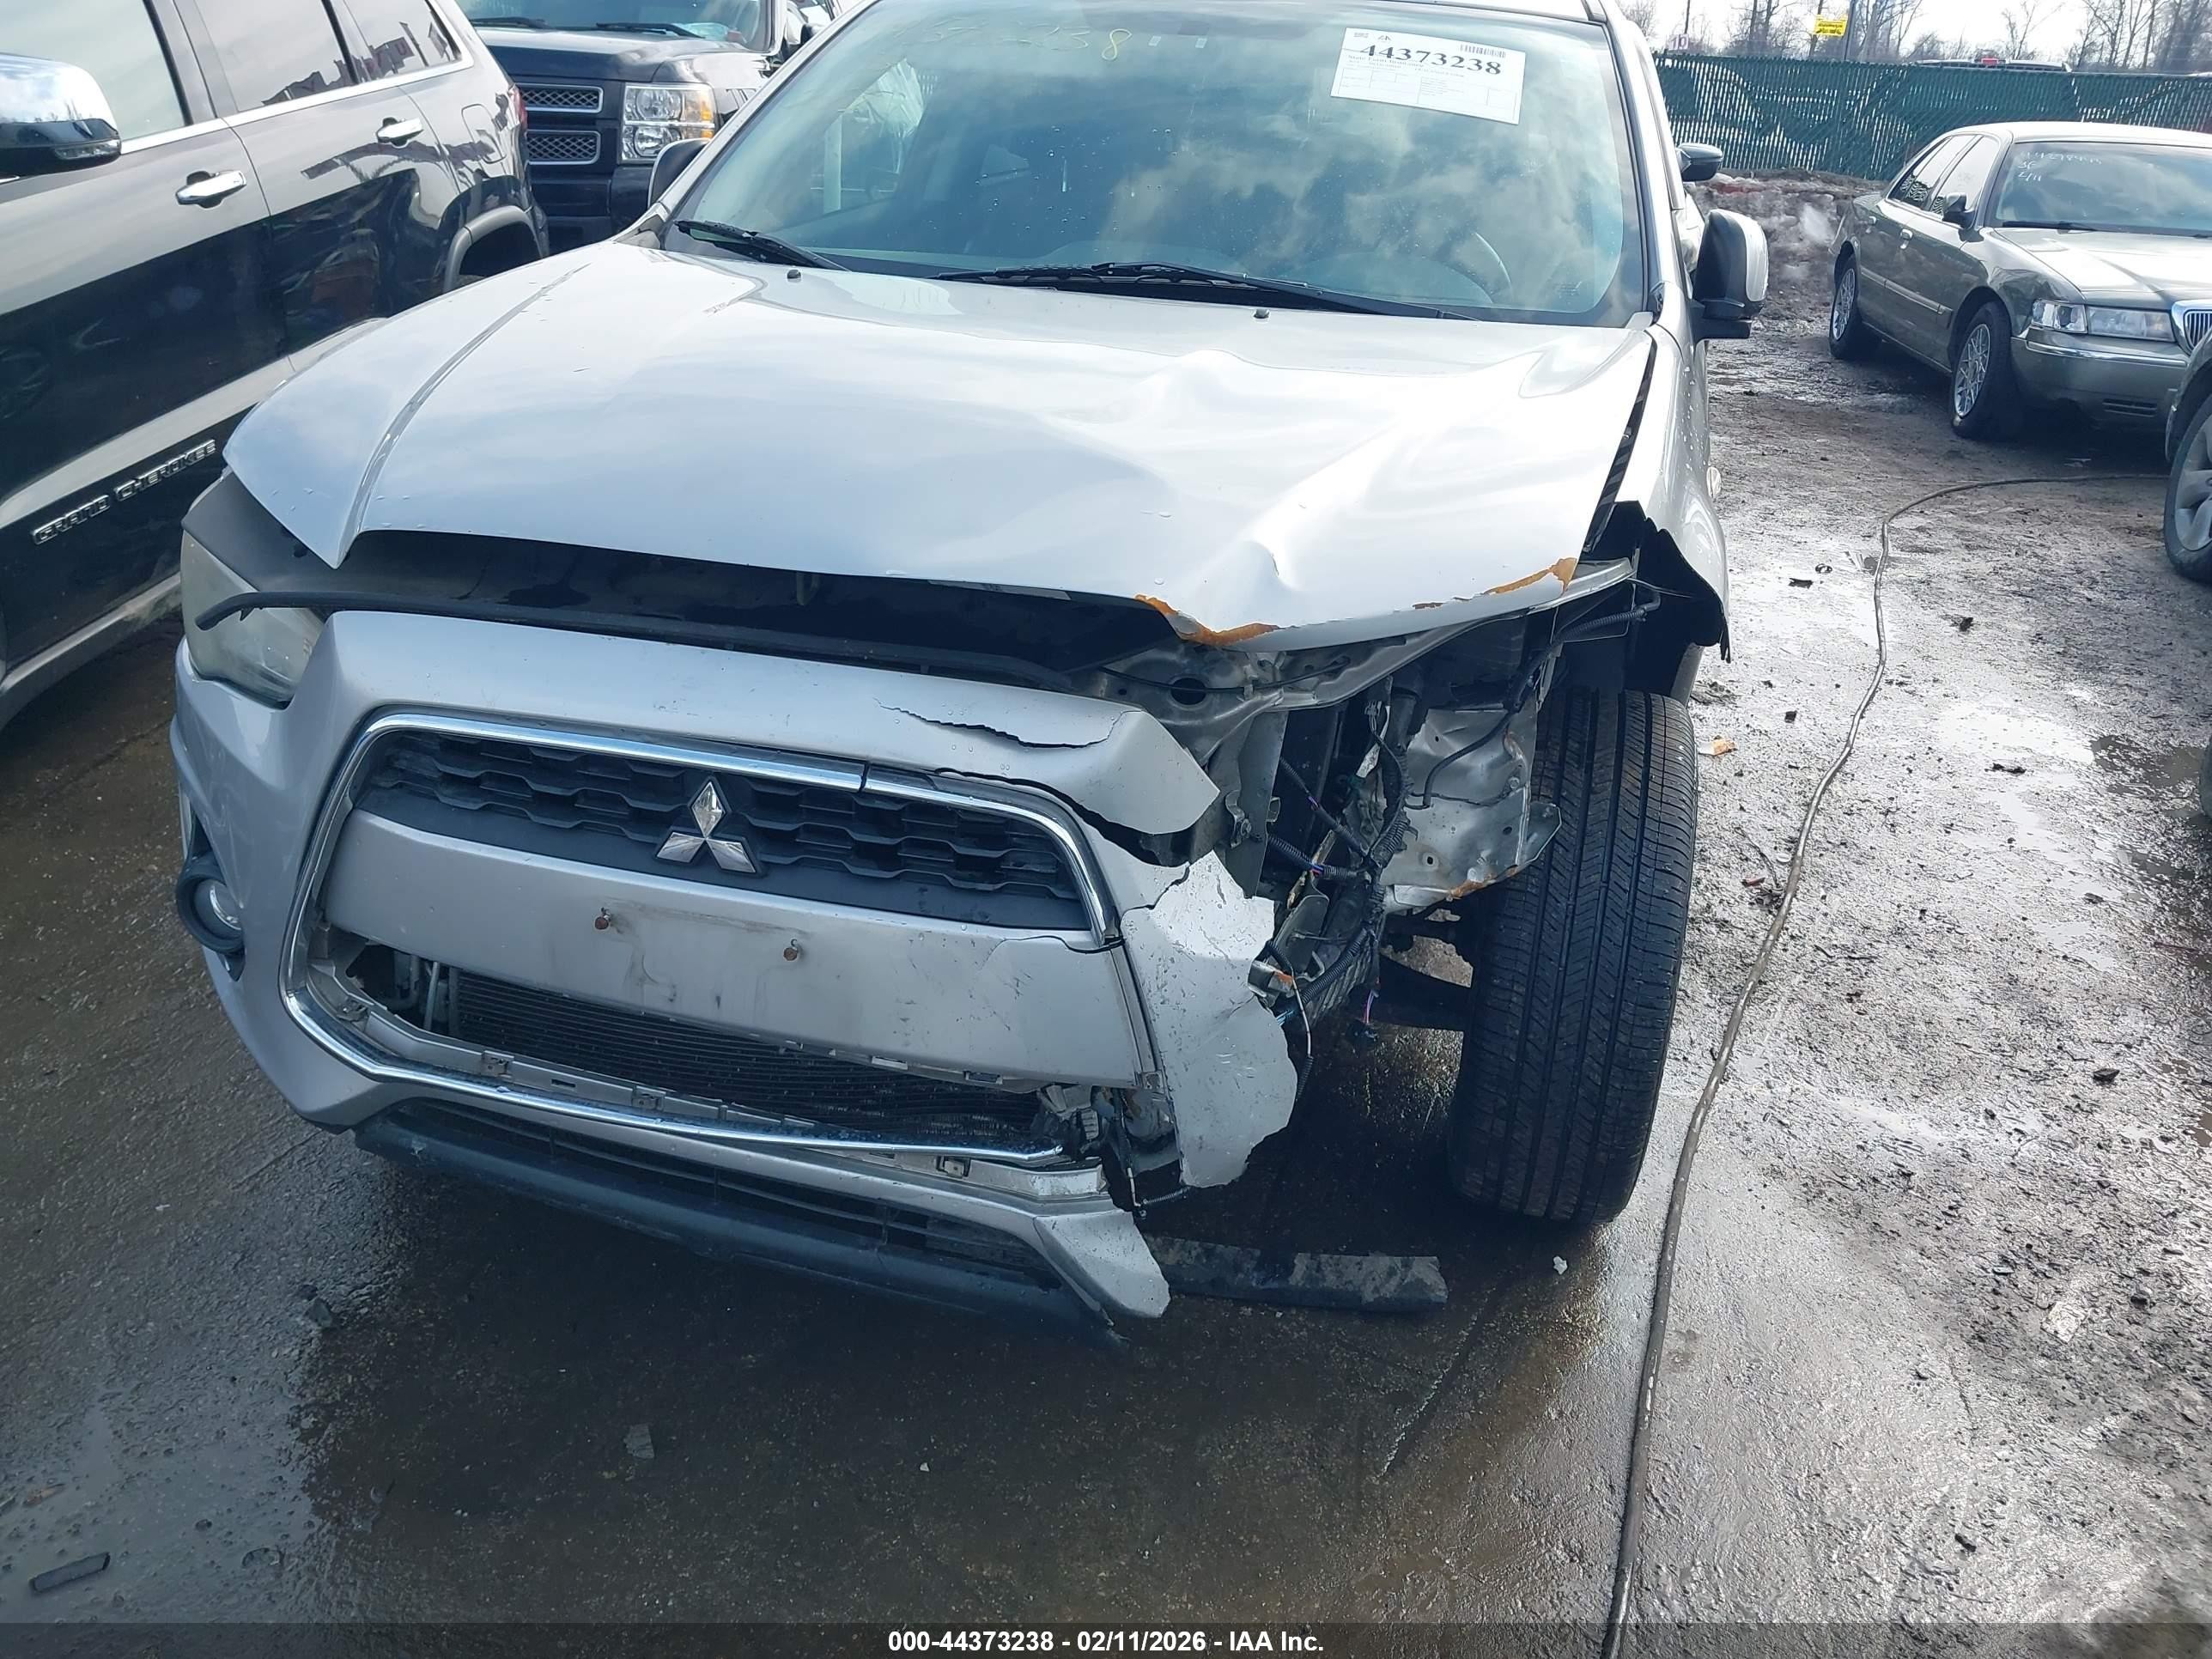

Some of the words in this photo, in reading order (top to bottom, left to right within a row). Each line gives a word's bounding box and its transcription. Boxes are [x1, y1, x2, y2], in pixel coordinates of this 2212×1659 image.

[1359, 44, 1502, 76] 44373238
[31, 494, 111, 544] GRAND
[112, 439, 216, 502] CHEROKEE
